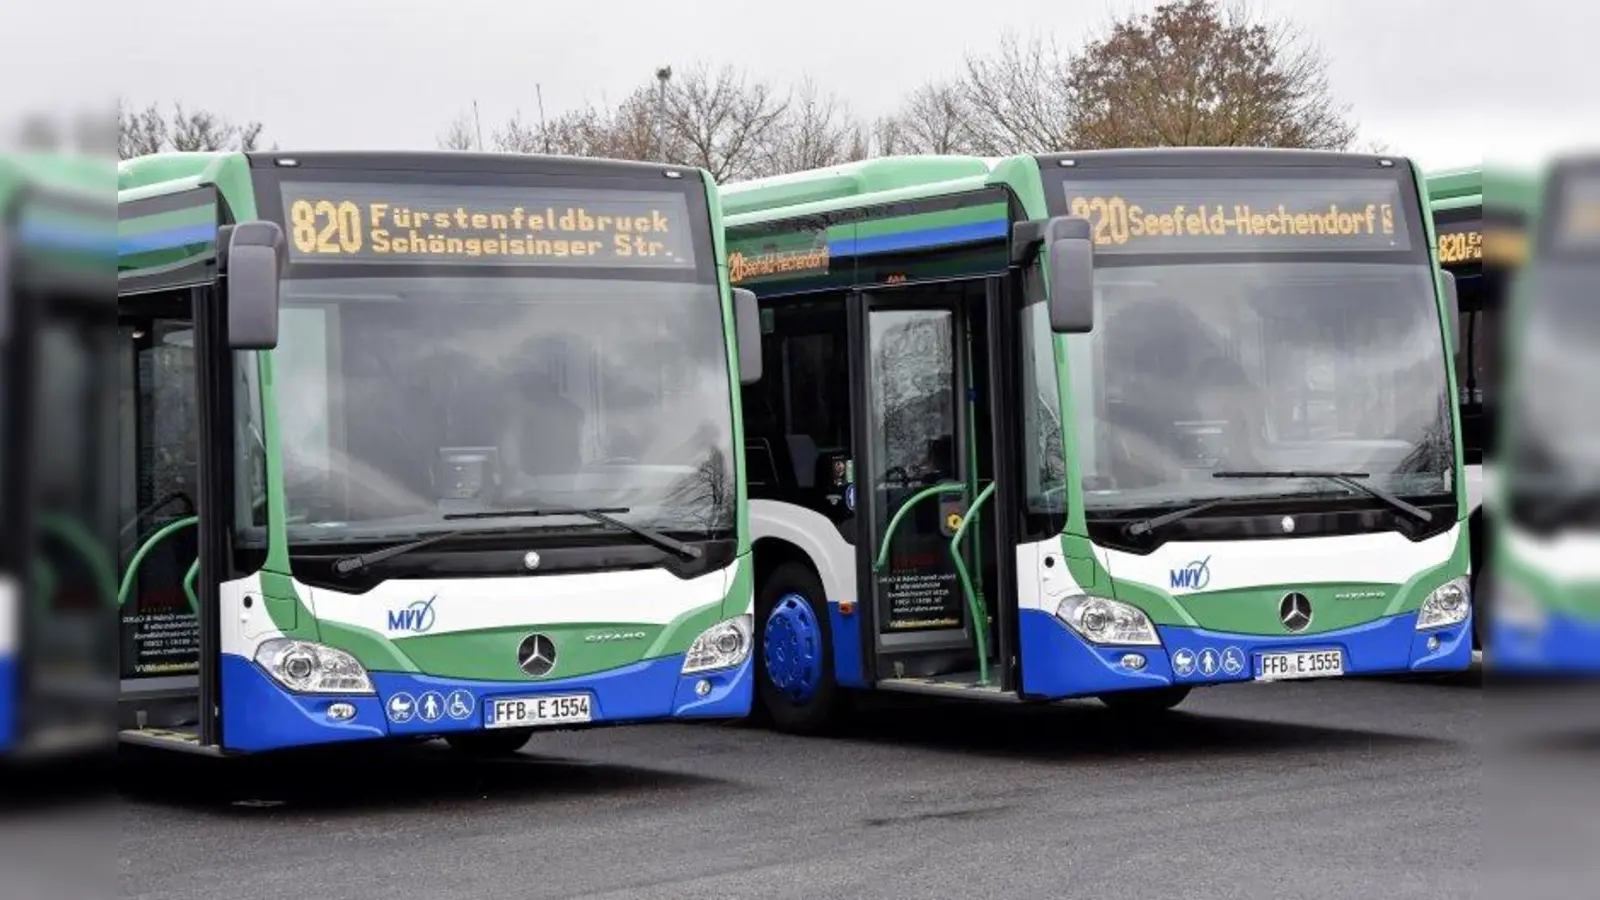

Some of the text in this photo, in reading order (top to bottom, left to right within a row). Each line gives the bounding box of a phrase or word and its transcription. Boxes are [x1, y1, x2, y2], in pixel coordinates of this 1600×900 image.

[291, 200, 362, 253] 820
[370, 204, 668, 232] Fürstenfeldbruck
[1129, 204, 1376, 236] Seefeld-Hechendorf
[371, 229, 673, 256] Schöngeisinger Str.
[1439, 233, 1465, 261] 820
[1170, 556, 1211, 589] MVV
[388, 596, 437, 633] MVV
[584, 631, 646, 642] CITARO
[1263, 652, 1341, 674] FFB E 1555
[496, 698, 589, 721] FFB E 1554
